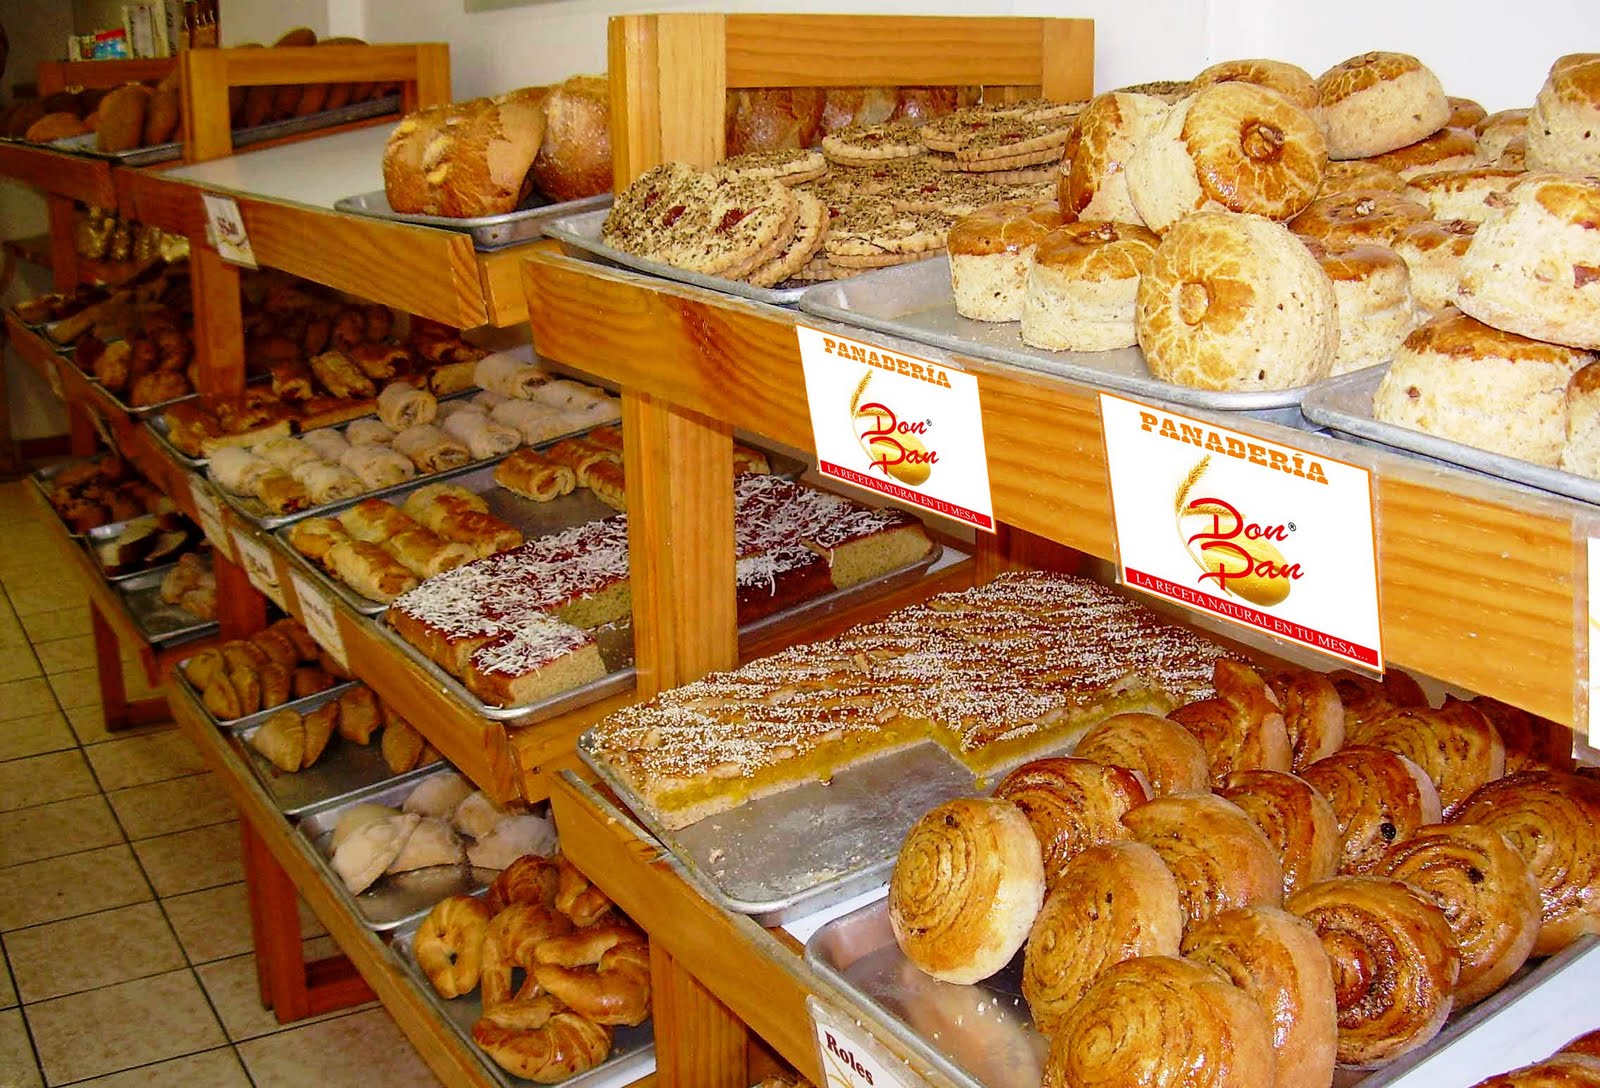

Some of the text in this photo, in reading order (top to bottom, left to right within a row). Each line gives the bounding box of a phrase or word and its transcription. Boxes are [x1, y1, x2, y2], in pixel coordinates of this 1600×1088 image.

[823, 337, 951, 388] PANADERÍA
[869, 436, 939, 475] Pan
[1139, 411, 1328, 485] PANADERÍA
[827, 464, 841, 476] LA
[841, 468, 875, 488] RECETA
[876, 480, 920, 502] NATURAL
[921, 496, 934, 507] EN
[935, 500, 948, 512] TU
[1197, 541, 1304, 590] Pan
[1135, 573, 1154, 587] LA
[1156, 579, 1205, 605] RECETA
[1207, 596, 1272, 628] NATURAL
[1274, 618, 1292, 634] EN
[1295, 624, 1314, 641] TU
[824, 1030, 874, 1086] Roles
